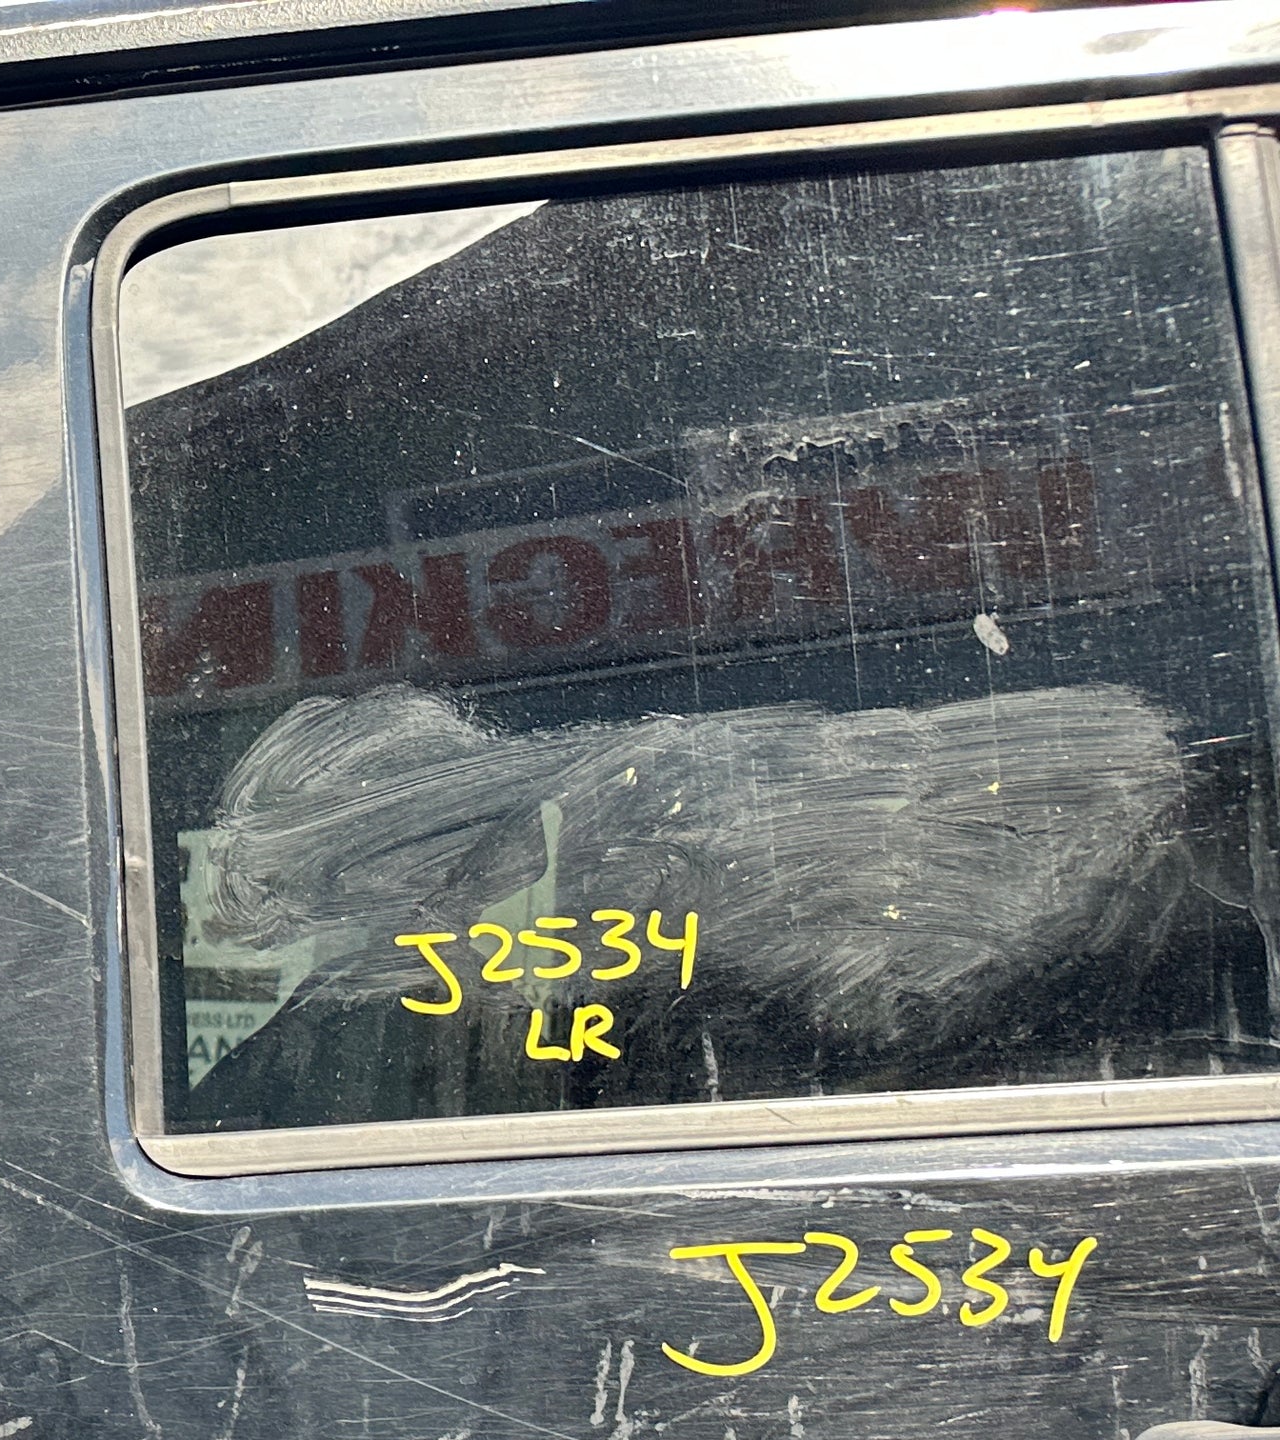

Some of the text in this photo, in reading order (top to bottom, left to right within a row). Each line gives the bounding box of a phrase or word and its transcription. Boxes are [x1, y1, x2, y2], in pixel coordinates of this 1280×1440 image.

[395, 909, 699, 1015] J2534
[525, 1004, 620, 1061] LR
[663, 1229, 1097, 1378] J2534
